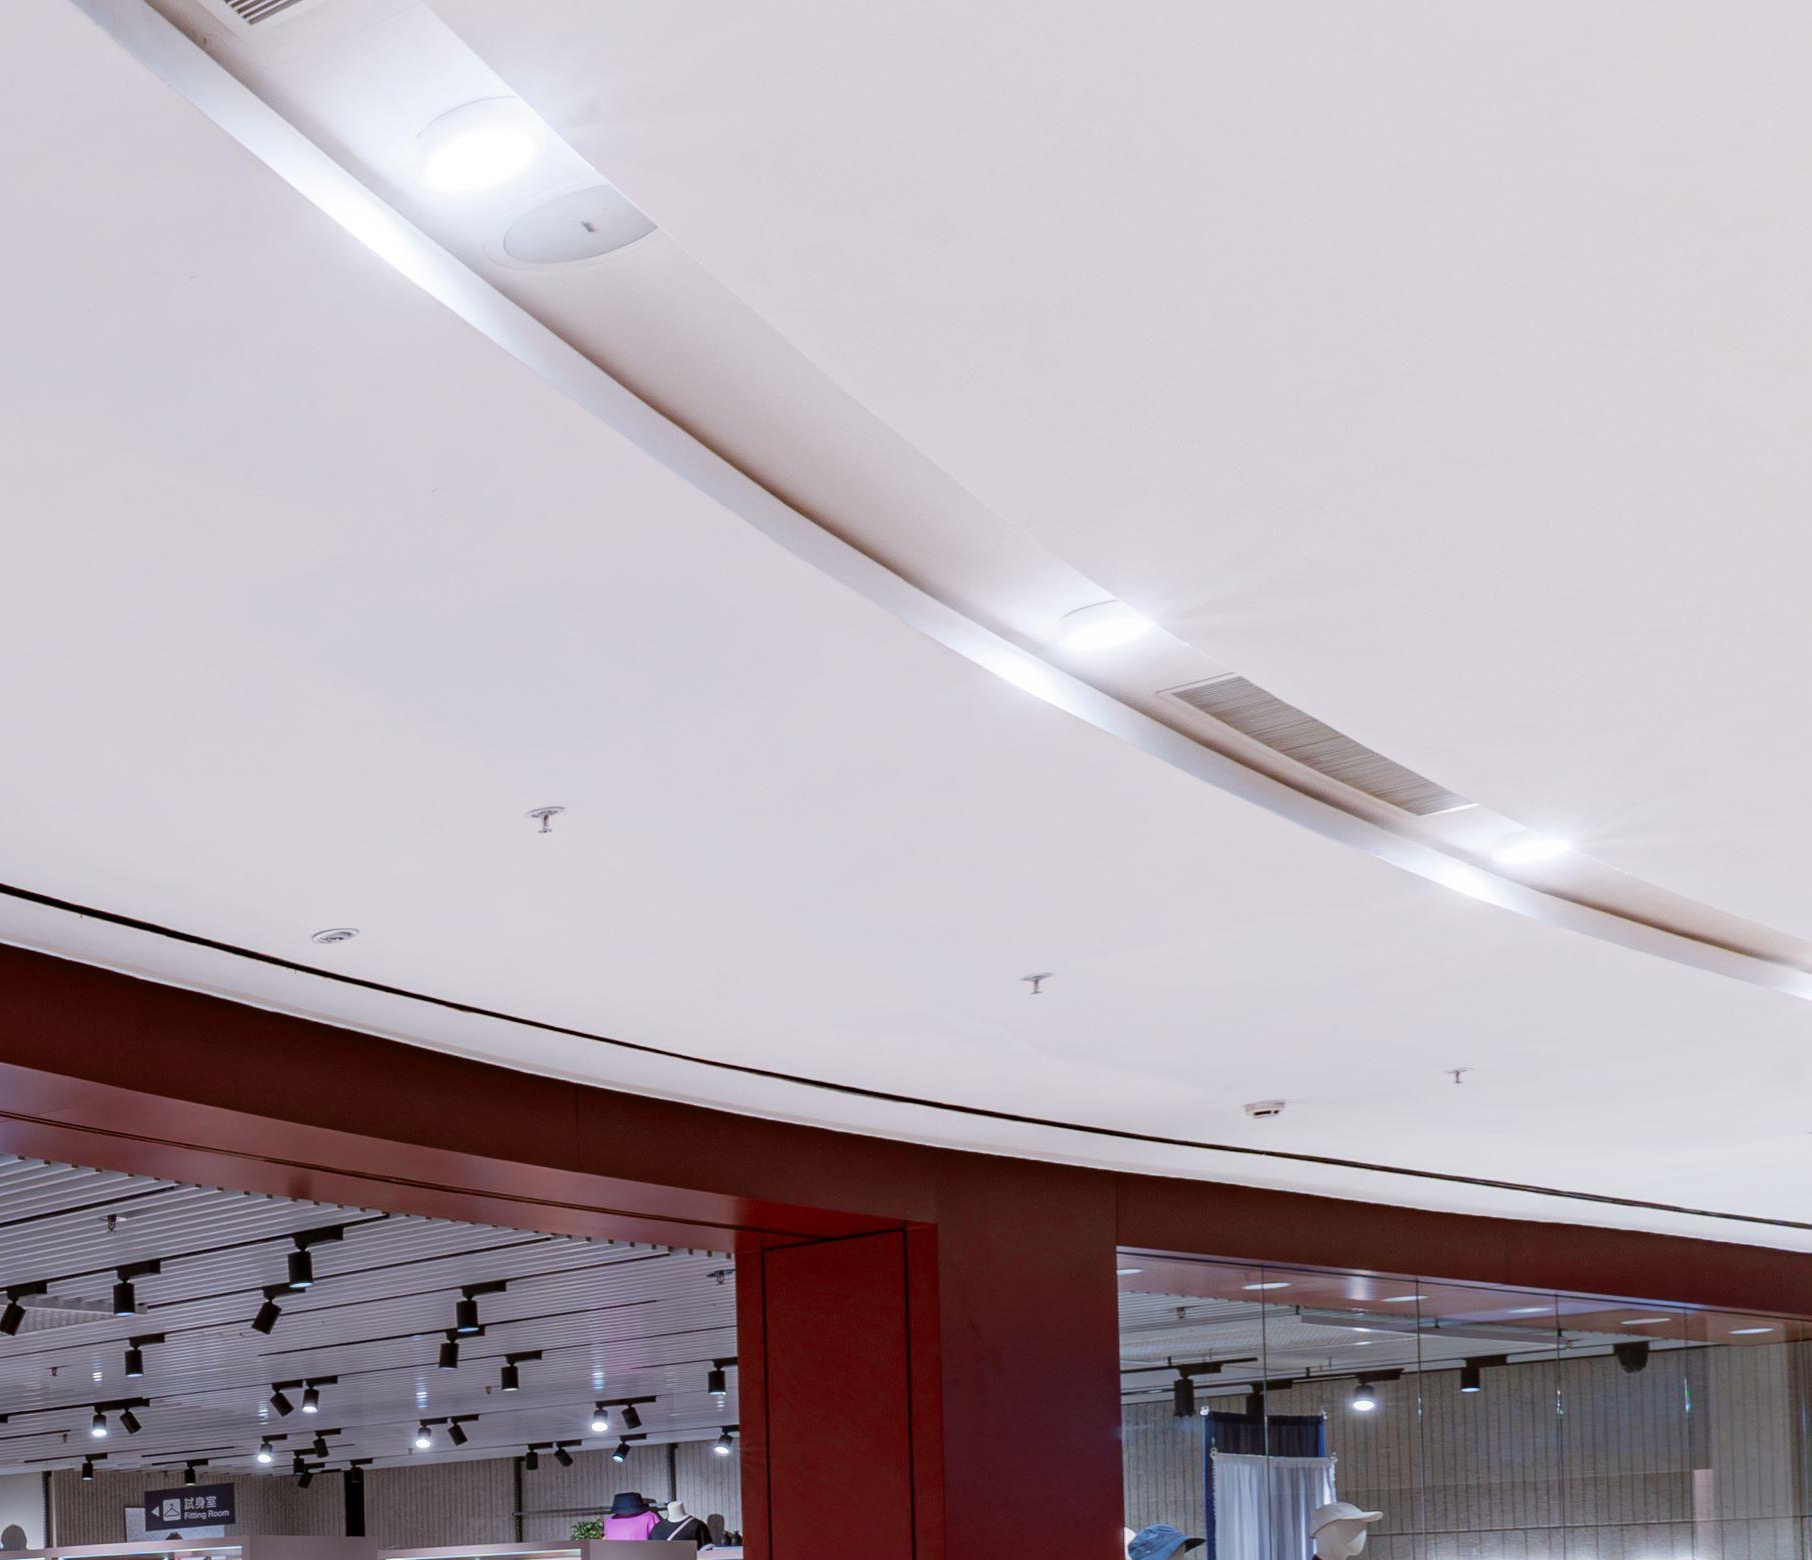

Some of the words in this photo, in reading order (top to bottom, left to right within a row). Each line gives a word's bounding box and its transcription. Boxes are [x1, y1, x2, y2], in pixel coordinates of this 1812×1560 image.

[184, 1496, 217, 1510] 試身室
[184, 1512, 207, 1520] Fitting
[208, 1509, 229, 1518] Room
